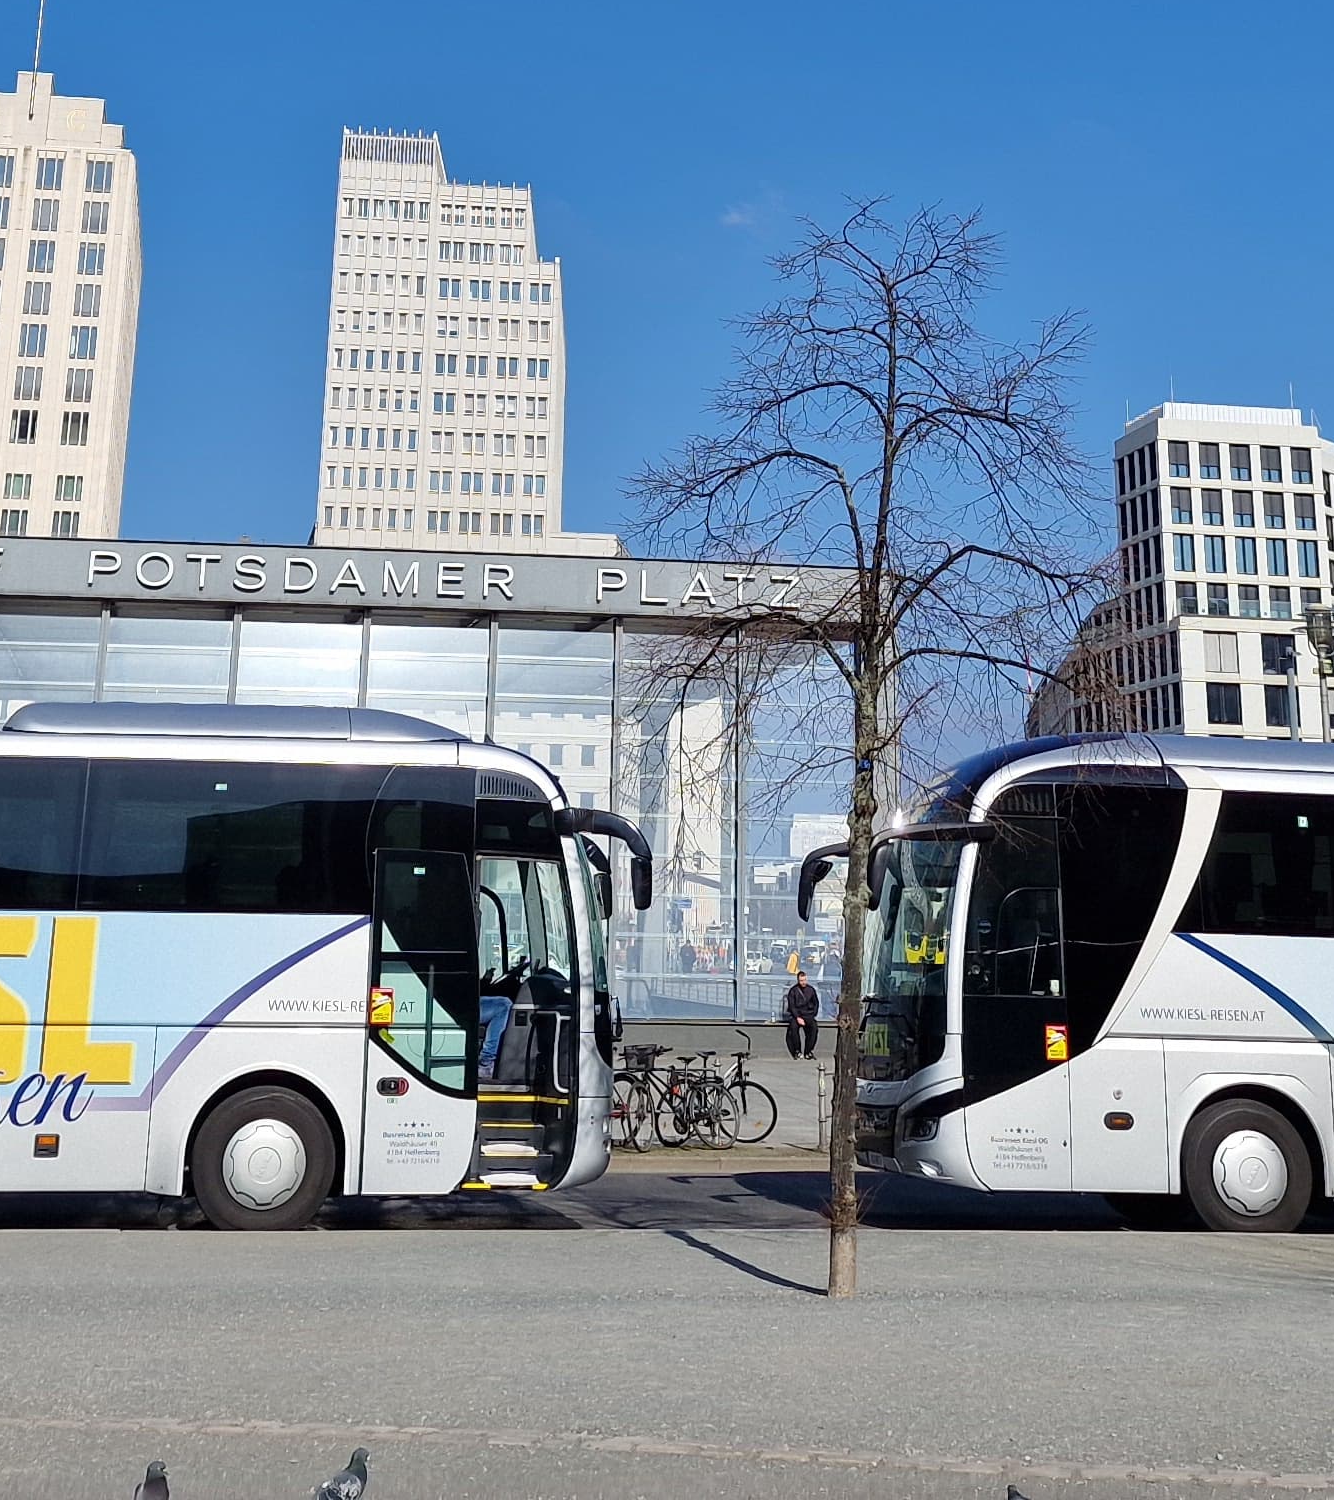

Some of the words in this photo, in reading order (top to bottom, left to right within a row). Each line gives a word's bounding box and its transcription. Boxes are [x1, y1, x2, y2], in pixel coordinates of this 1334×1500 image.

[87, 550, 514, 598] POTSDAMER
[596, 567, 802, 611] PLATZ
[1140, 1008, 1265, 1022] WWW.KIESL-REISEN.AT
